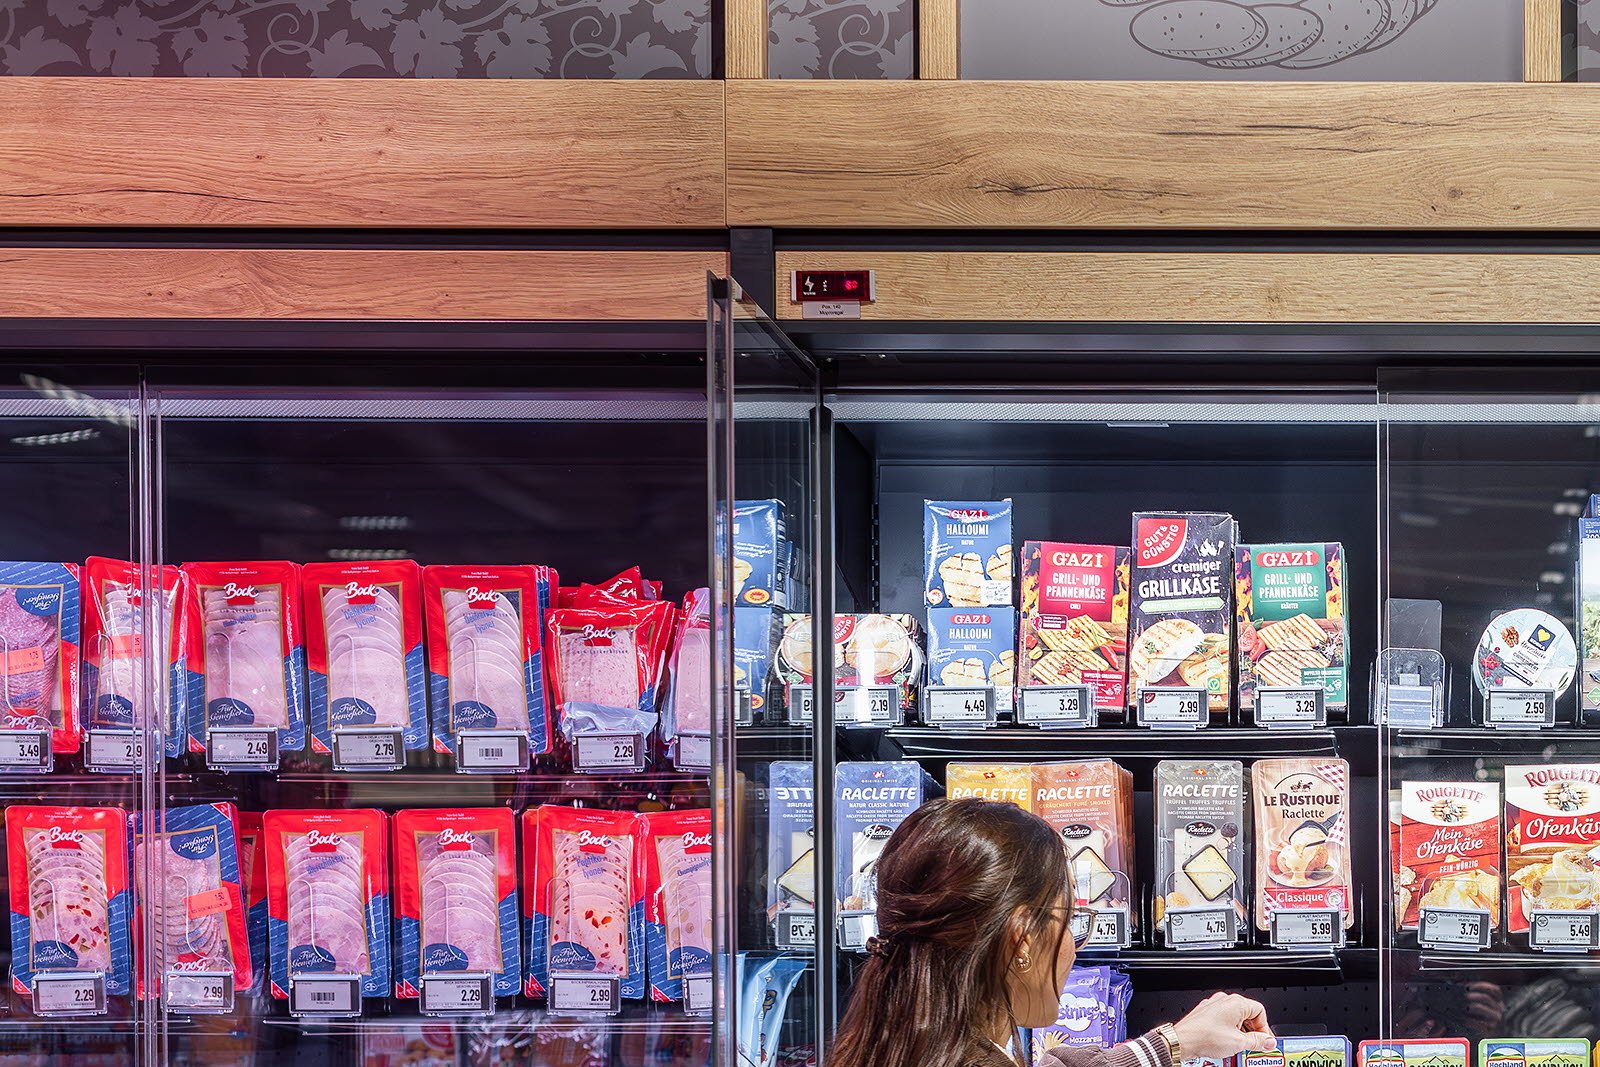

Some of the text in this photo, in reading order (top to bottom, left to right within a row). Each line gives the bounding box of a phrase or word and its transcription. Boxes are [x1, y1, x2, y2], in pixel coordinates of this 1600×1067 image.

[946, 524, 988, 535] HALLOUMI
[1142, 524, 1180, 560] GÜNSTIG
[1172, 559, 1222, 575] cremiger
[1052, 573, 1100, 585] GRILL- UND
[1138, 573, 1221, 598] GRILLKÄSE
[1264, 573, 1312, 584] GRILL- UND
[223, 583, 259, 599] Bock
[344, 582, 381, 598] Bock
[465, 586, 502, 603] Bock
[1046, 585, 1106, 600] PFANNENKÄSE
[1259, 584, 1319, 599] PFANNENKÄSE
[949, 628, 992, 640] HALLOUMI
[18, 745, 40, 758] 3.49
[247, 741, 268, 755] 2.49
[375, 744, 395, 757] 2.79
[841, 787, 918, 801] RACLETTE
[1036, 785, 1112, 801] RACLETTE
[1162, 784, 1239, 798] RACLETTE
[1415, 786, 1485, 803] ROUGETTE
[1281, 809, 1325, 819] Raclette
[438, 828, 475, 845] Bock
[578, 830, 613, 847] Bock
[1061, 827, 1092, 837] Raclette
[1430, 828, 1464, 844] Mein
[1416, 837, 1484, 858] Ofenkäse
[1276, 891, 1324, 904] Classique
[1096, 922, 1117, 935] 4.79
[1206, 921, 1227, 934] 4.79
[74, 988, 95, 1002] 2.29
[203, 986, 223, 999] 2.99
[590, 988, 610, 1002] 2.99
[1248, 1056, 1283, 1067] Hochland
